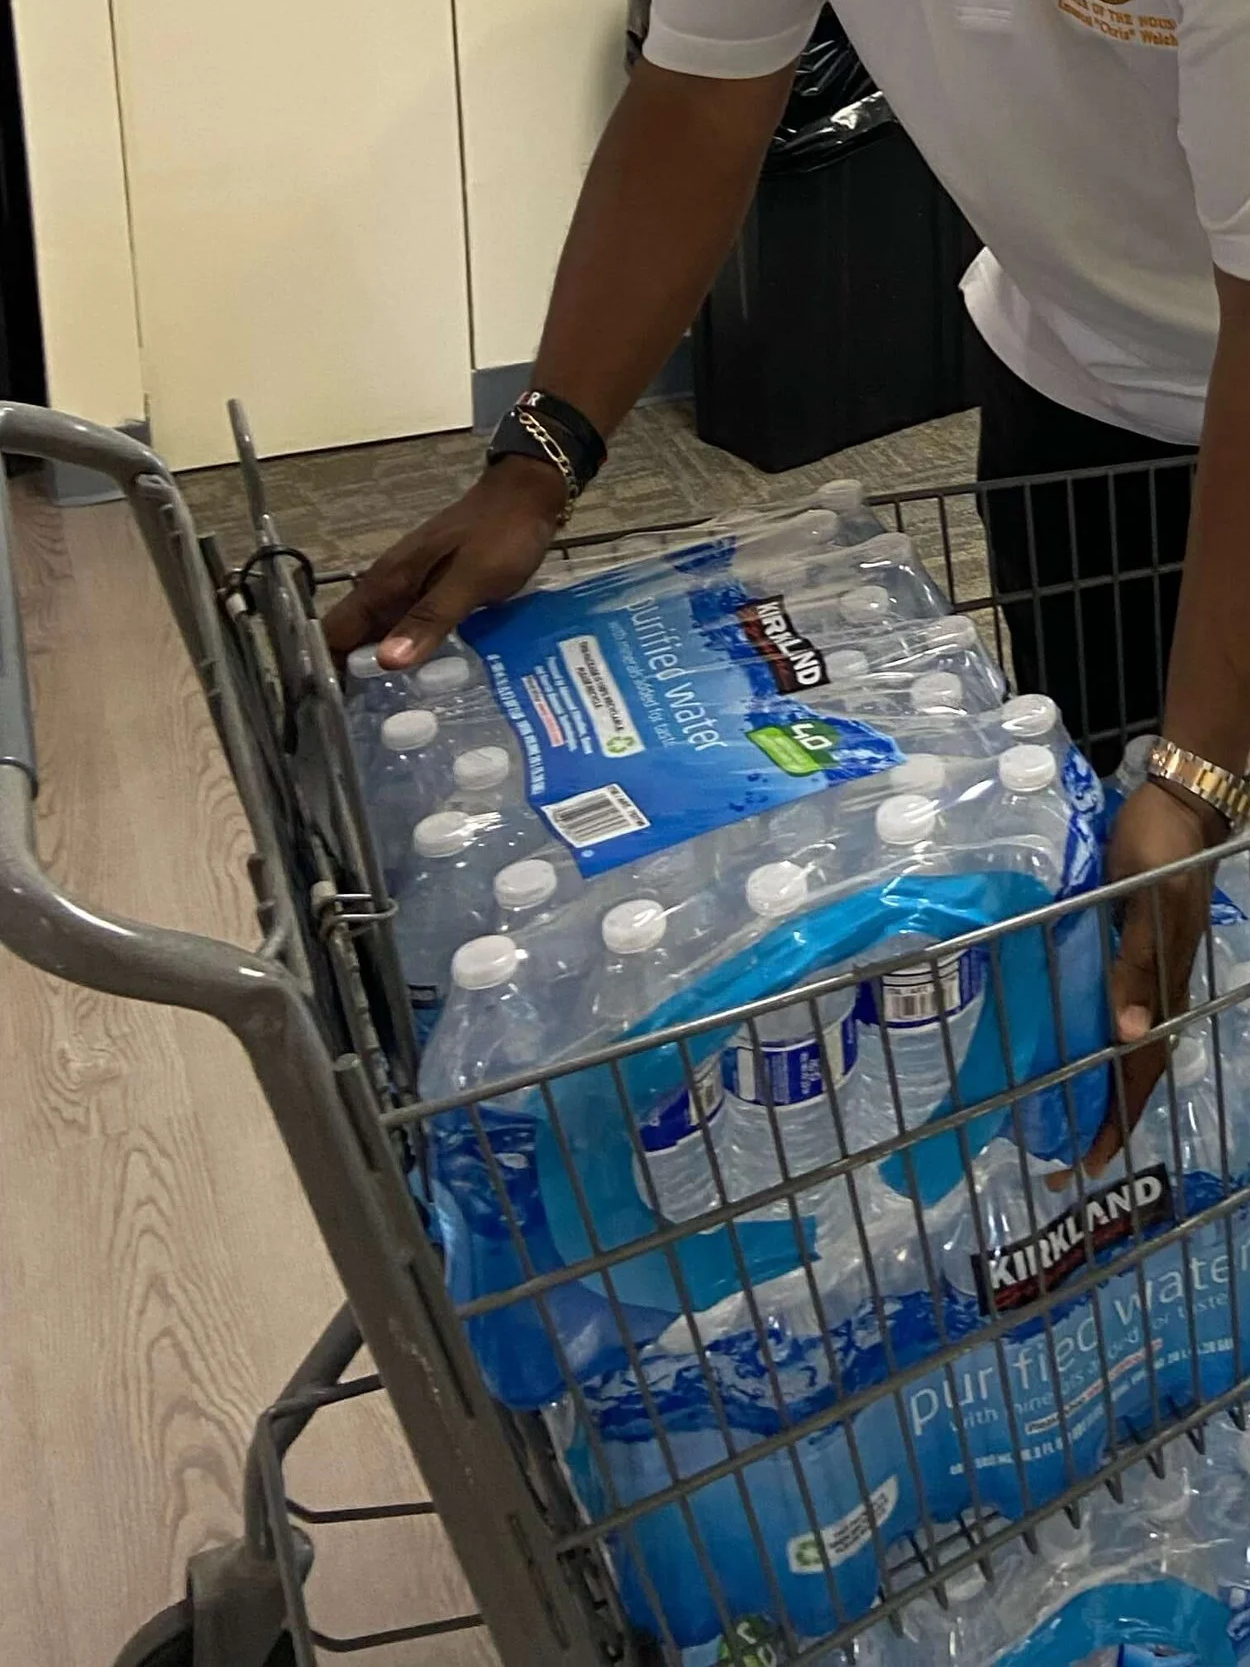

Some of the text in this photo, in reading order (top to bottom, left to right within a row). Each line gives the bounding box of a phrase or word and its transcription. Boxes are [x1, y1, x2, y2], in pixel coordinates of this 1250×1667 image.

[626, 597, 728, 752] purified water
[791, 723, 832, 751] 40
[989, 1176, 1163, 1290] KIRKLAND
